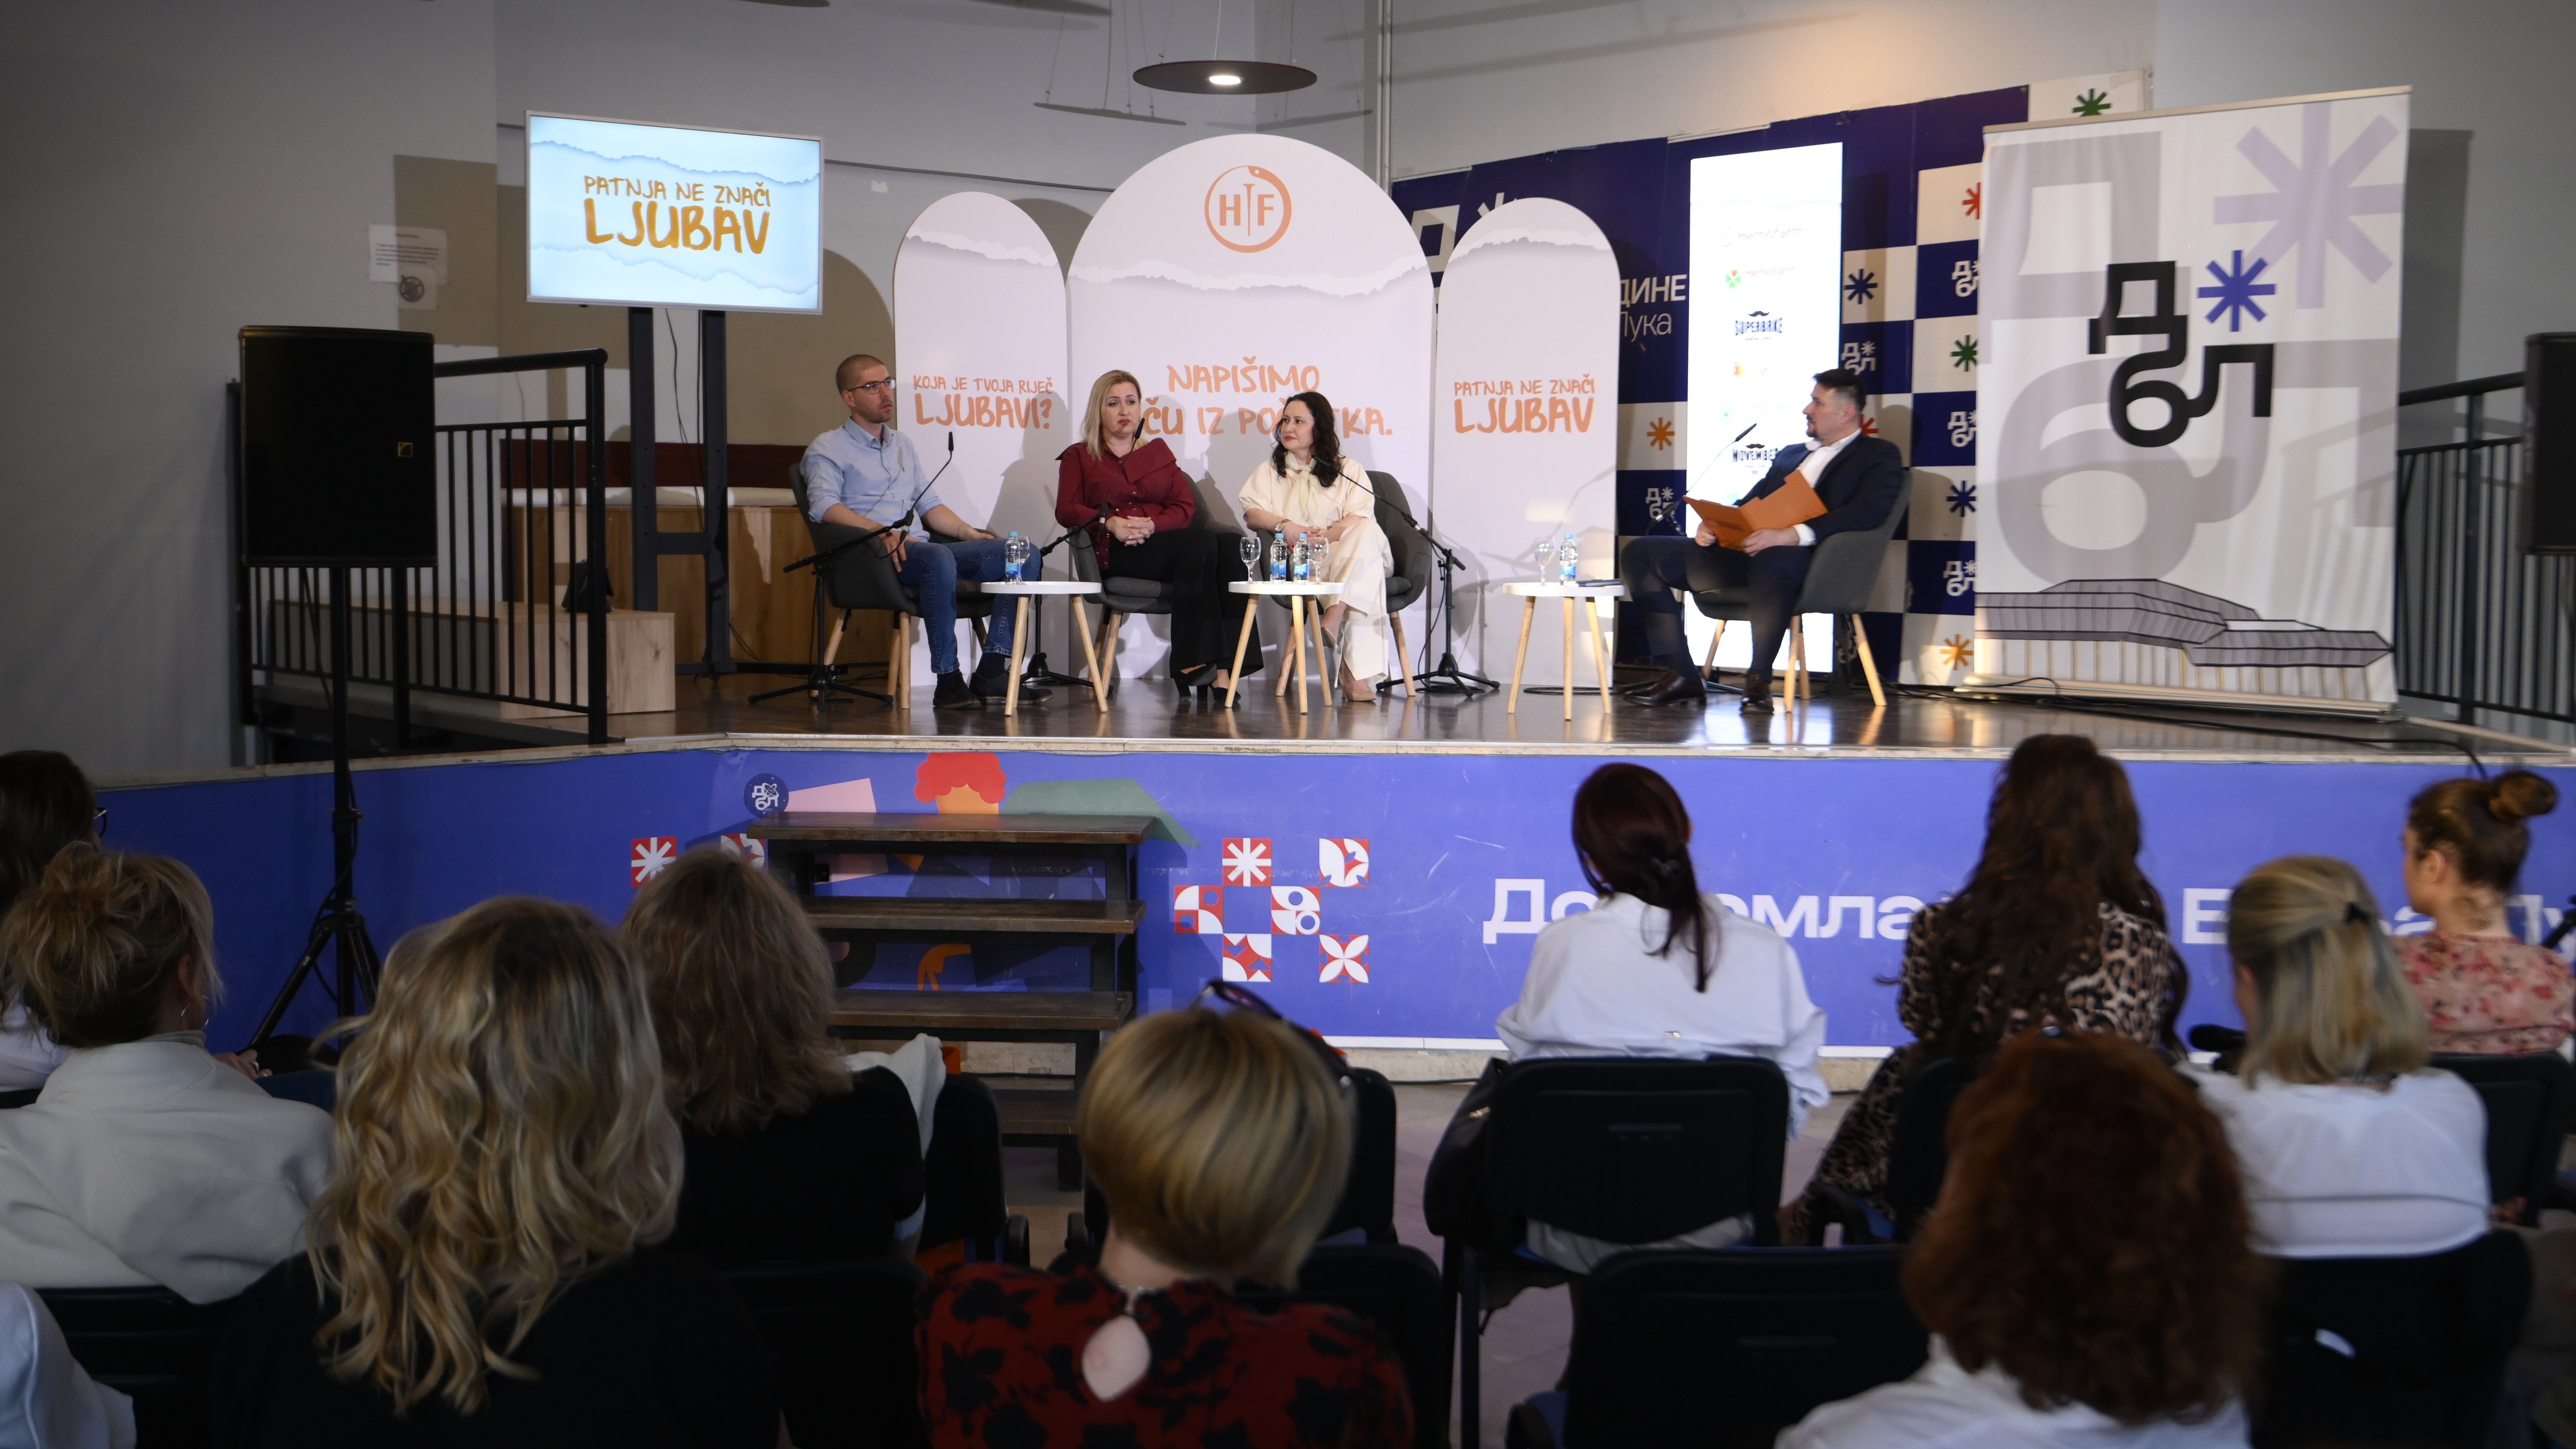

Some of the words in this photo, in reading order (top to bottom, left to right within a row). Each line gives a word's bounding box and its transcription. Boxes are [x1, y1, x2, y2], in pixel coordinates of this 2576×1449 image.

[584, 175, 667, 200] PATNJA
[676, 181, 705, 201] NE
[714, 182, 771, 207] ZNAČI
[584, 198, 770, 255] LJUBAV
[913, 375, 946, 390] KOJA
[952, 377, 968, 390] JE
[973, 377, 1014, 393] TVOJA
[1019, 377, 1053, 394] RIJEČ
[1166, 356, 1320, 393] NAPIŠIMO
[1454, 379, 1514, 396] PATNJA
[1521, 379, 1542, 395] NE
[1550, 374, 1596, 395] ZNAČI
[914, 392, 1052, 429] LJUBAVI?
[1197, 407, 1225, 435] IZ
[1454, 396, 1595, 434] LJUBAV
